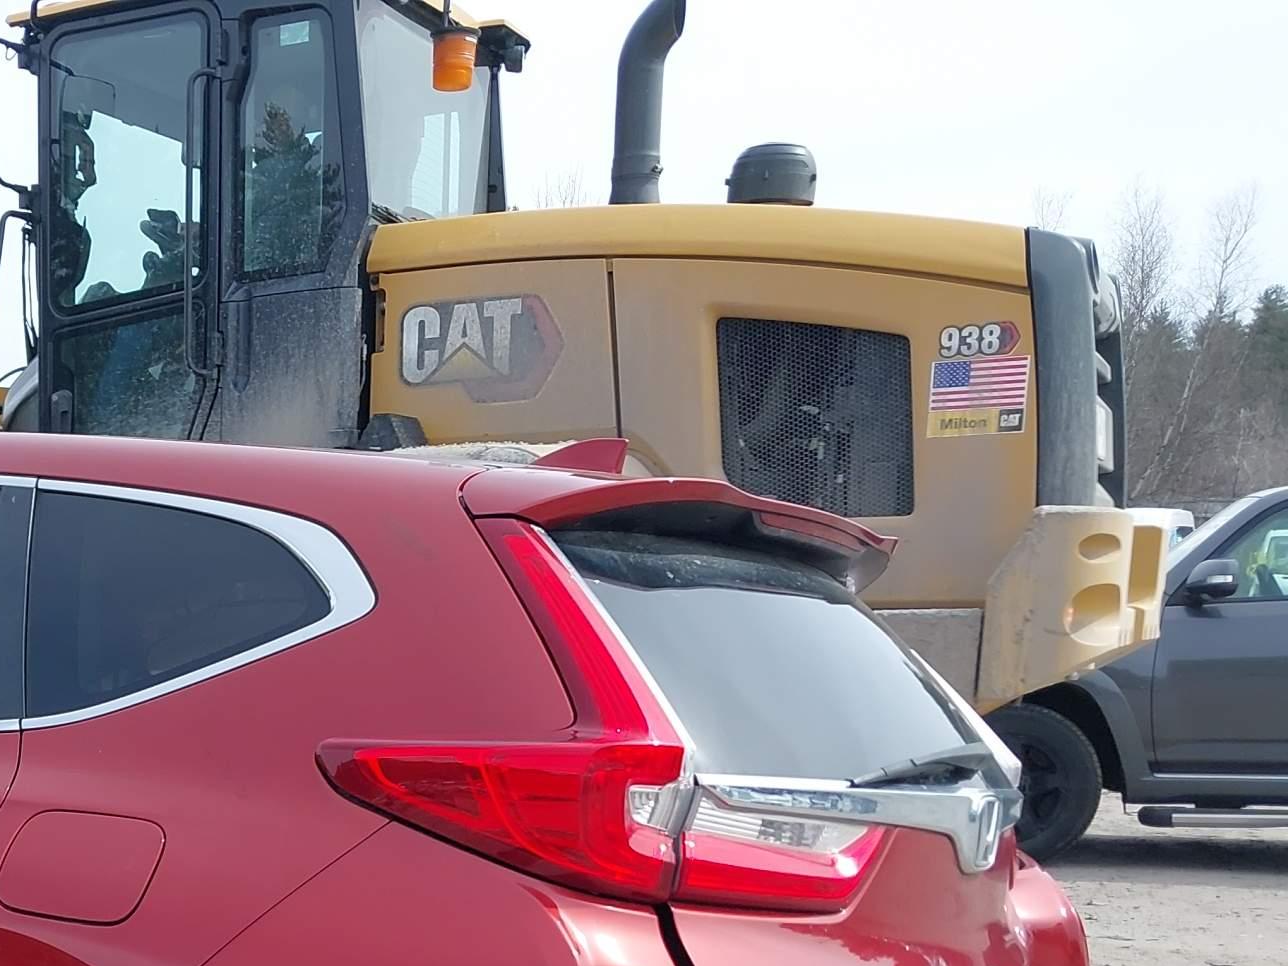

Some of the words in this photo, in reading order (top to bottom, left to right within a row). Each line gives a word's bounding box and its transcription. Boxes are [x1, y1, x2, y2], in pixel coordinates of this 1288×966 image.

[402, 298, 522, 384] CAT
[939, 323, 1002, 357] 938
[940, 418, 987, 430] Milton
[999, 413, 1021, 427] CAT
